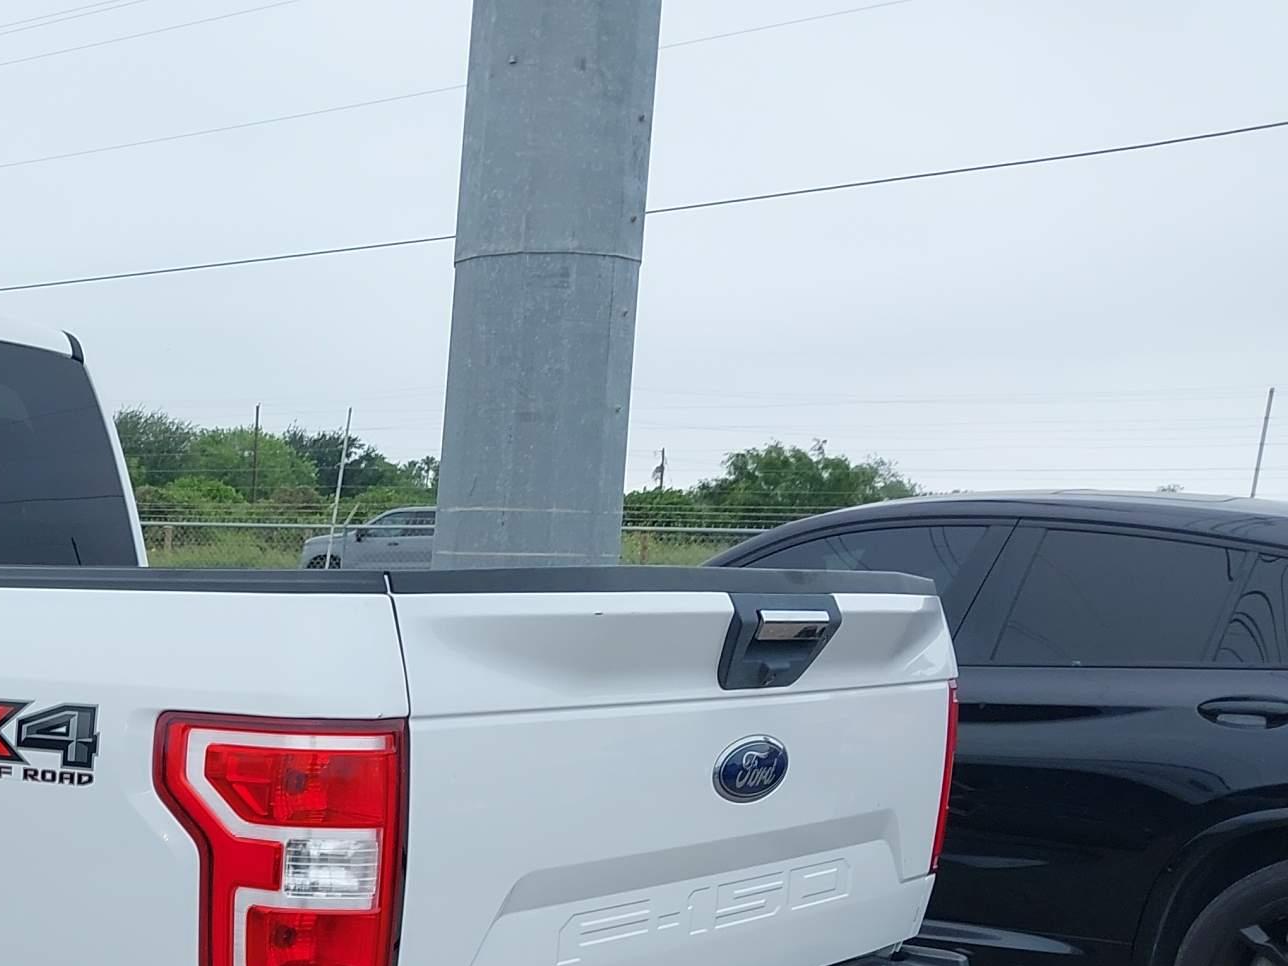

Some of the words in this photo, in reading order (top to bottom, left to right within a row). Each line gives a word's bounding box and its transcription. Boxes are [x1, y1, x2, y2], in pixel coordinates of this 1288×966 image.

[22, 768, 94, 786] ROAD
[735, 751, 777, 788] Ford
[554, 857, 851, 966] F-150
